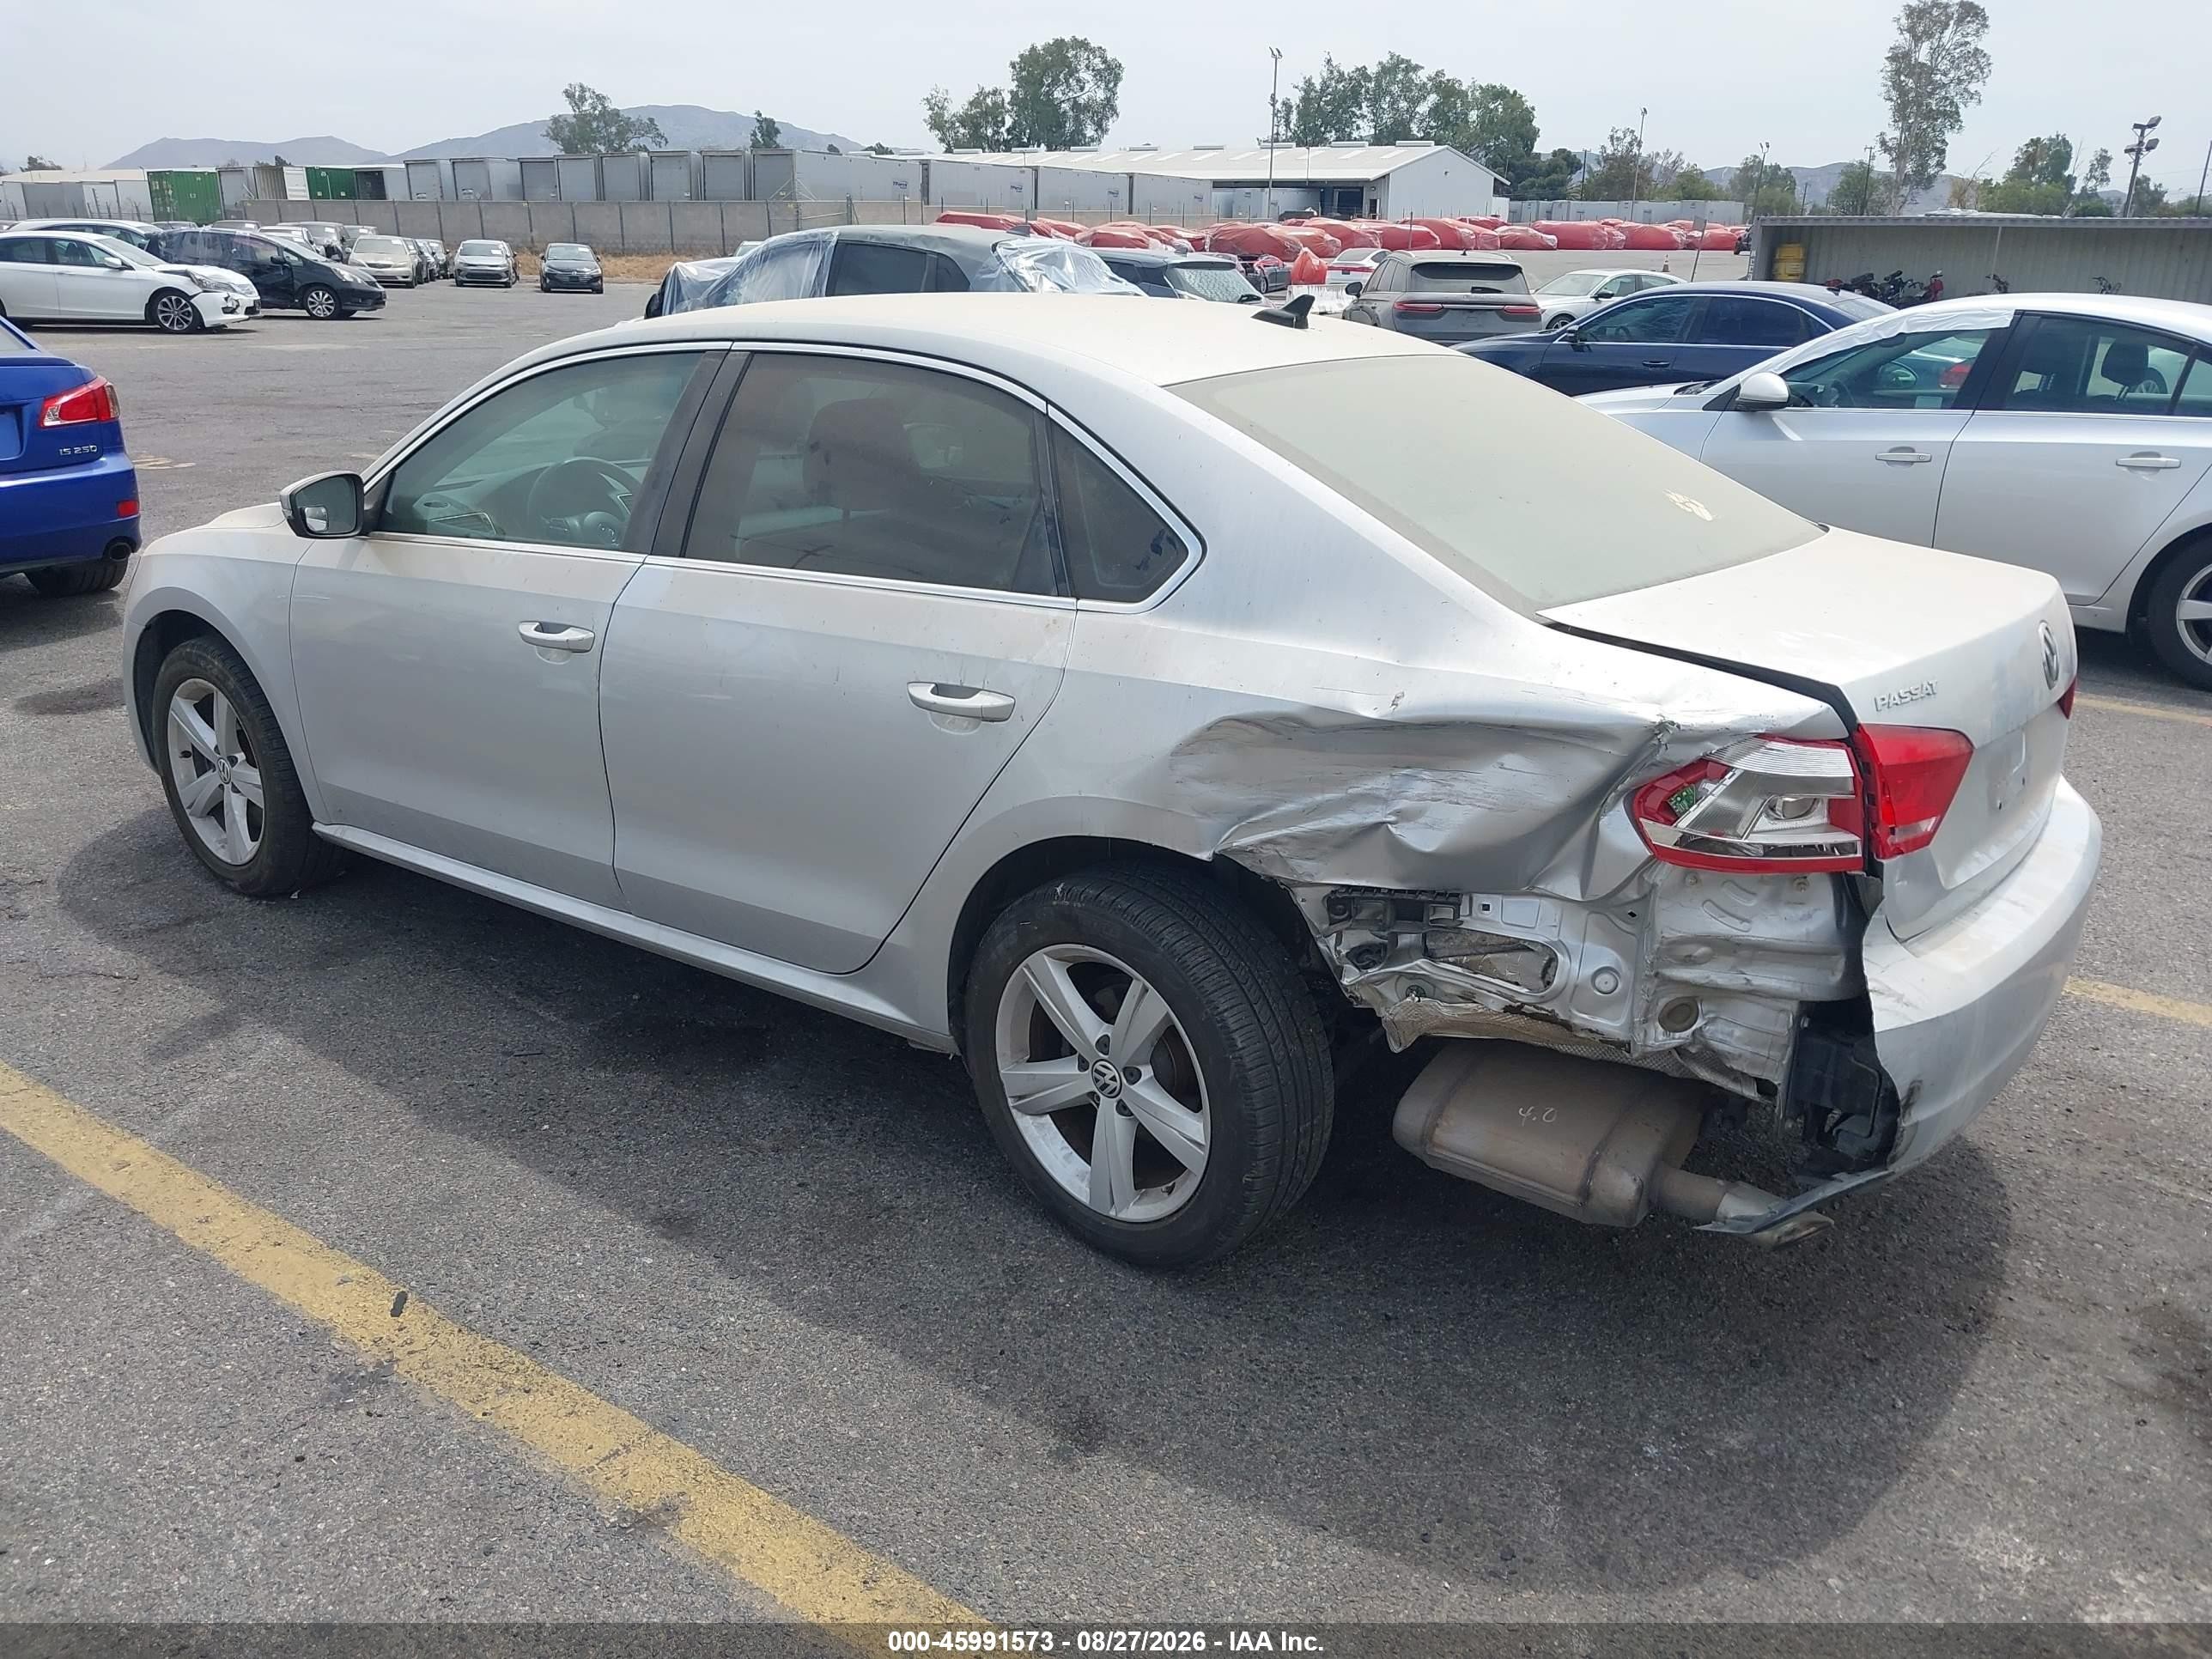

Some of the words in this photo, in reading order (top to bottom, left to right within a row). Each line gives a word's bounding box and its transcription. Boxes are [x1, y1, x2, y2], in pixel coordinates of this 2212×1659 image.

[59, 447, 71, 456] IS
[74, 445, 98, 454] 250
[1874, 680, 1938, 712] PASSAT
